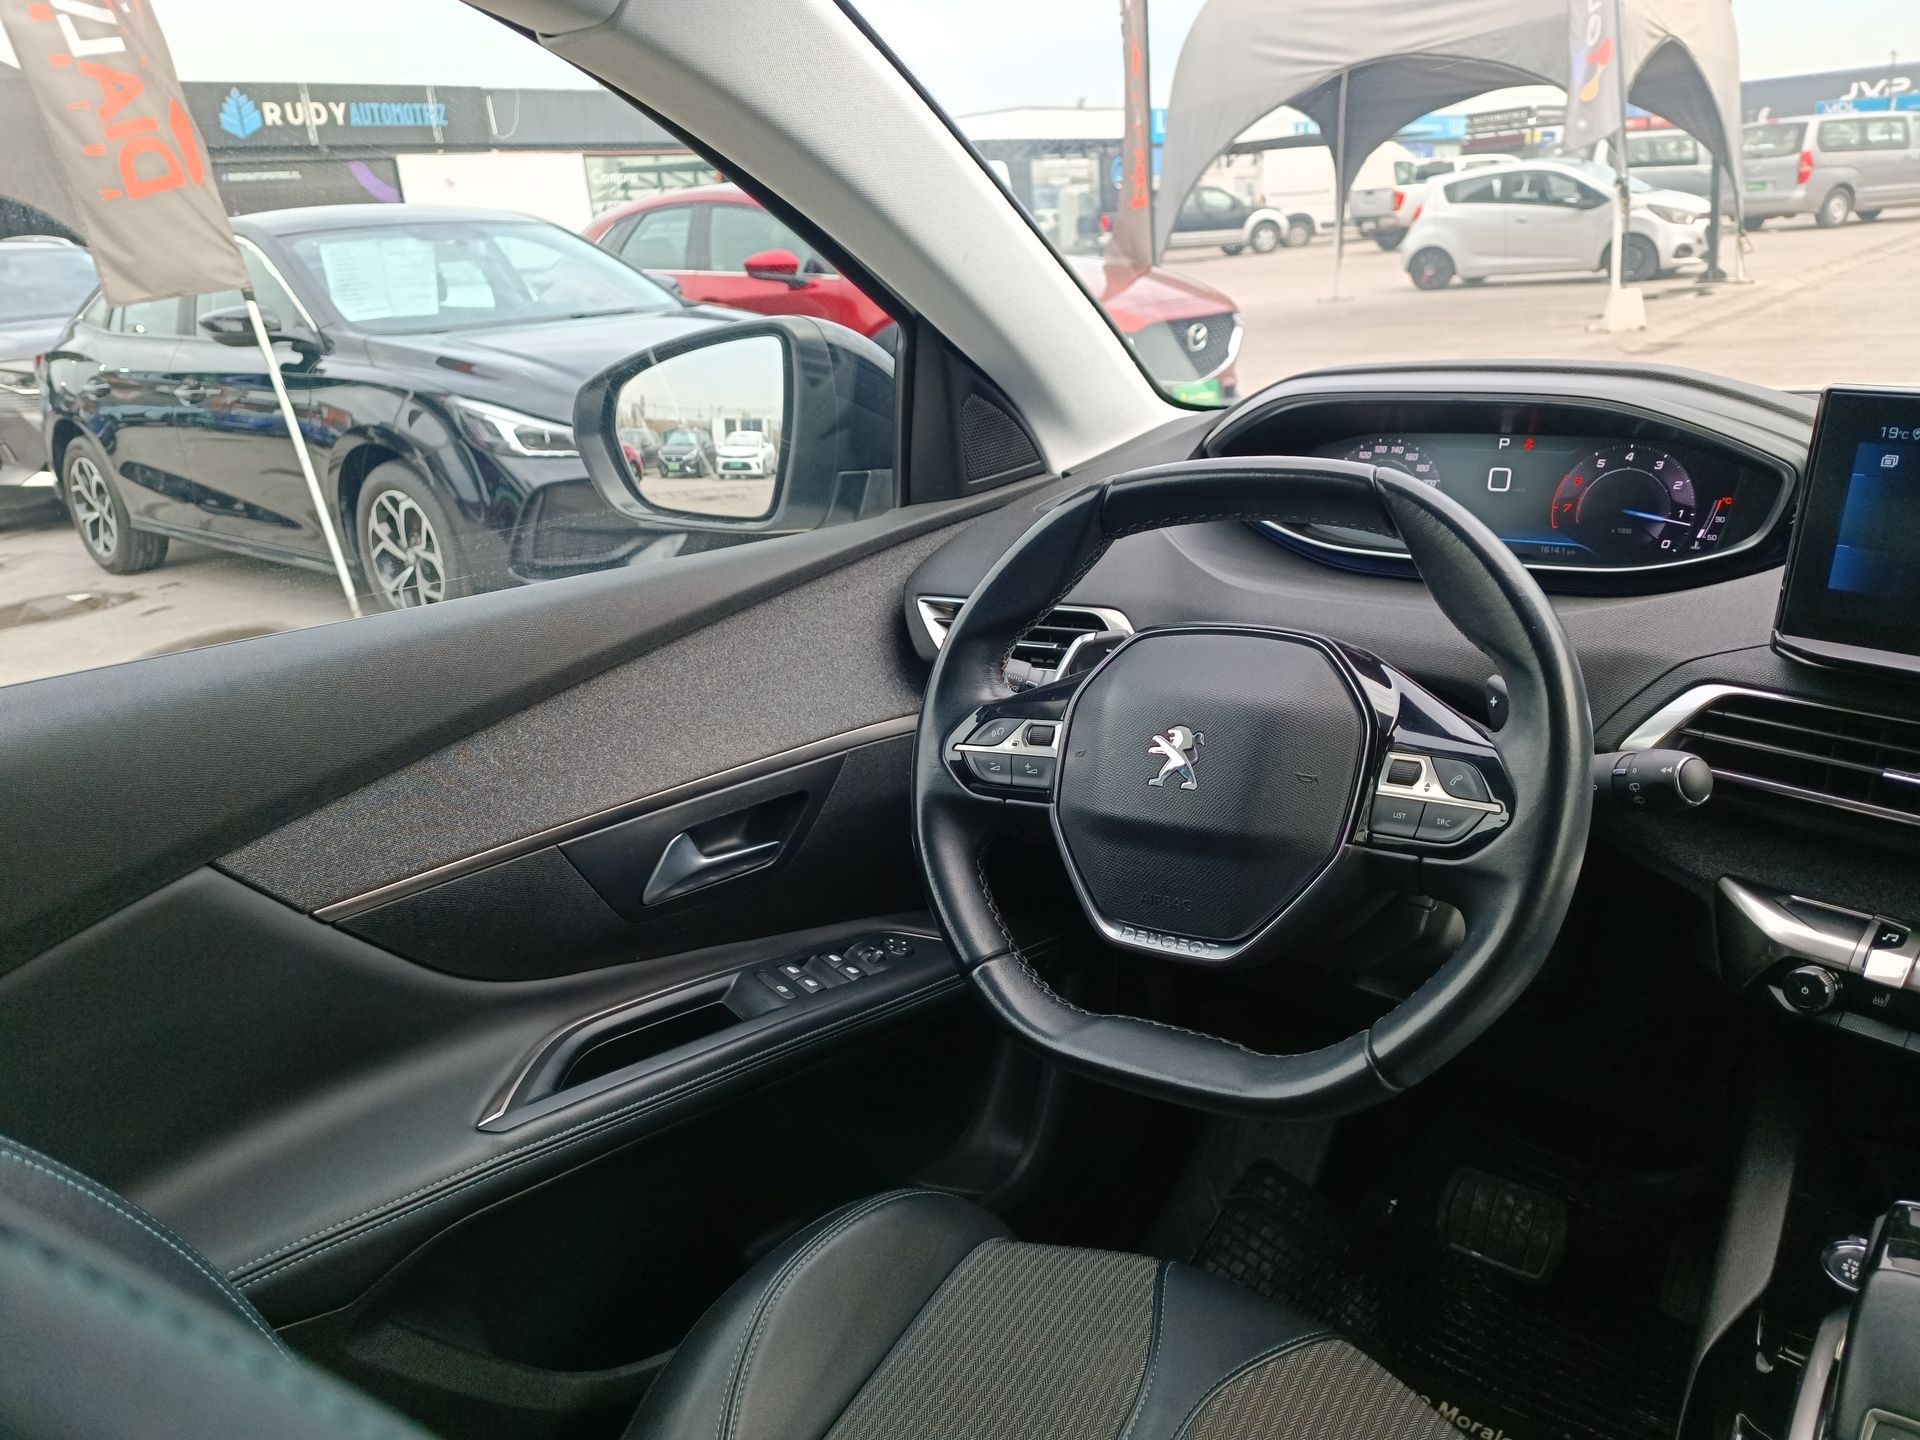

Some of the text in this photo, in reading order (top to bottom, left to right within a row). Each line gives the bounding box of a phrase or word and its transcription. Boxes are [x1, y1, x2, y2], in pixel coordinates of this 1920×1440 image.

[1839, 77, 1912, 101] JVP
[261, 101, 346, 127] RUDY
[1499, 437, 1511, 450] P
[1374, 445, 1388, 454] 120
[1390, 445, 1405, 454] 140
[1358, 451, 1372, 460] 100
[1405, 452, 1419, 461] 160
[1624, 452, 1636, 462] 4
[1596, 458, 1607, 468] 5
[1654, 460, 1665, 470] 3
[1487, 466, 1513, 493] 0
[1573, 476, 1583, 486] 6
[1673, 480, 1684, 490] 2
[1563, 503, 1573, 513] 7
[1678, 509, 1684, 518] 1
[1714, 516, 1726, 524] 90
[1706, 534, 1718, 542] 50
[1661, 539, 1672, 549] 0
[1392, 812, 1407, 820] LIST
[1436, 817, 1451, 827] SRC
[1119, 925, 1220, 956] PEUGEOT
